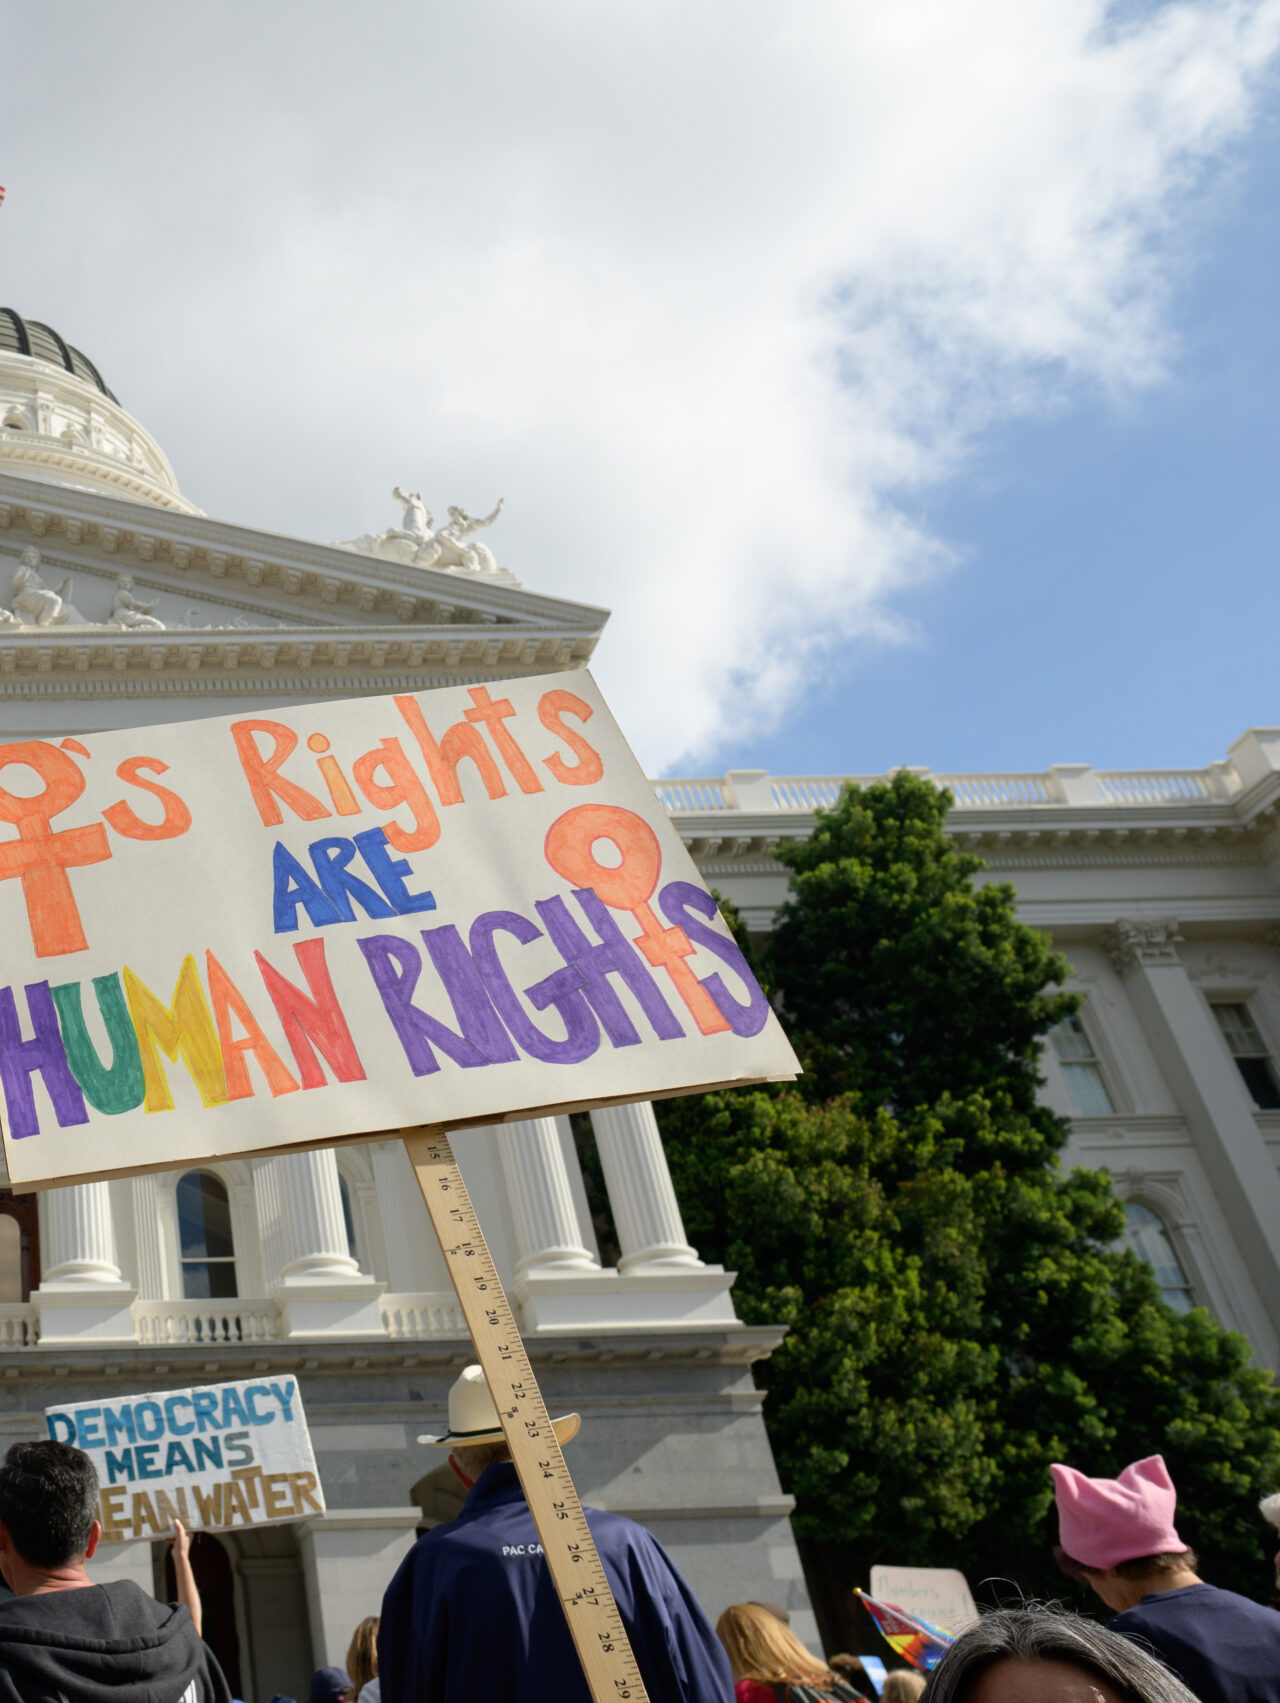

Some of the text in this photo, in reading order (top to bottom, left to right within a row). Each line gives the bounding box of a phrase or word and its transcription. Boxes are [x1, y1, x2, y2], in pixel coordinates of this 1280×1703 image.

[230, 686, 604, 853] Rights
[273, 826, 437, 934] ARE
[46, 1381, 295, 1450] DEMOCRACY
[427, 1146, 631, 1699] 15 16 17 18 19 20 21 22 23 24 25 26 27 28 29
[104, 1431, 254, 1484] MEANS
[192, 1466, 324, 1527] WATER
[502, 1543, 544, 1556] PAC CA
